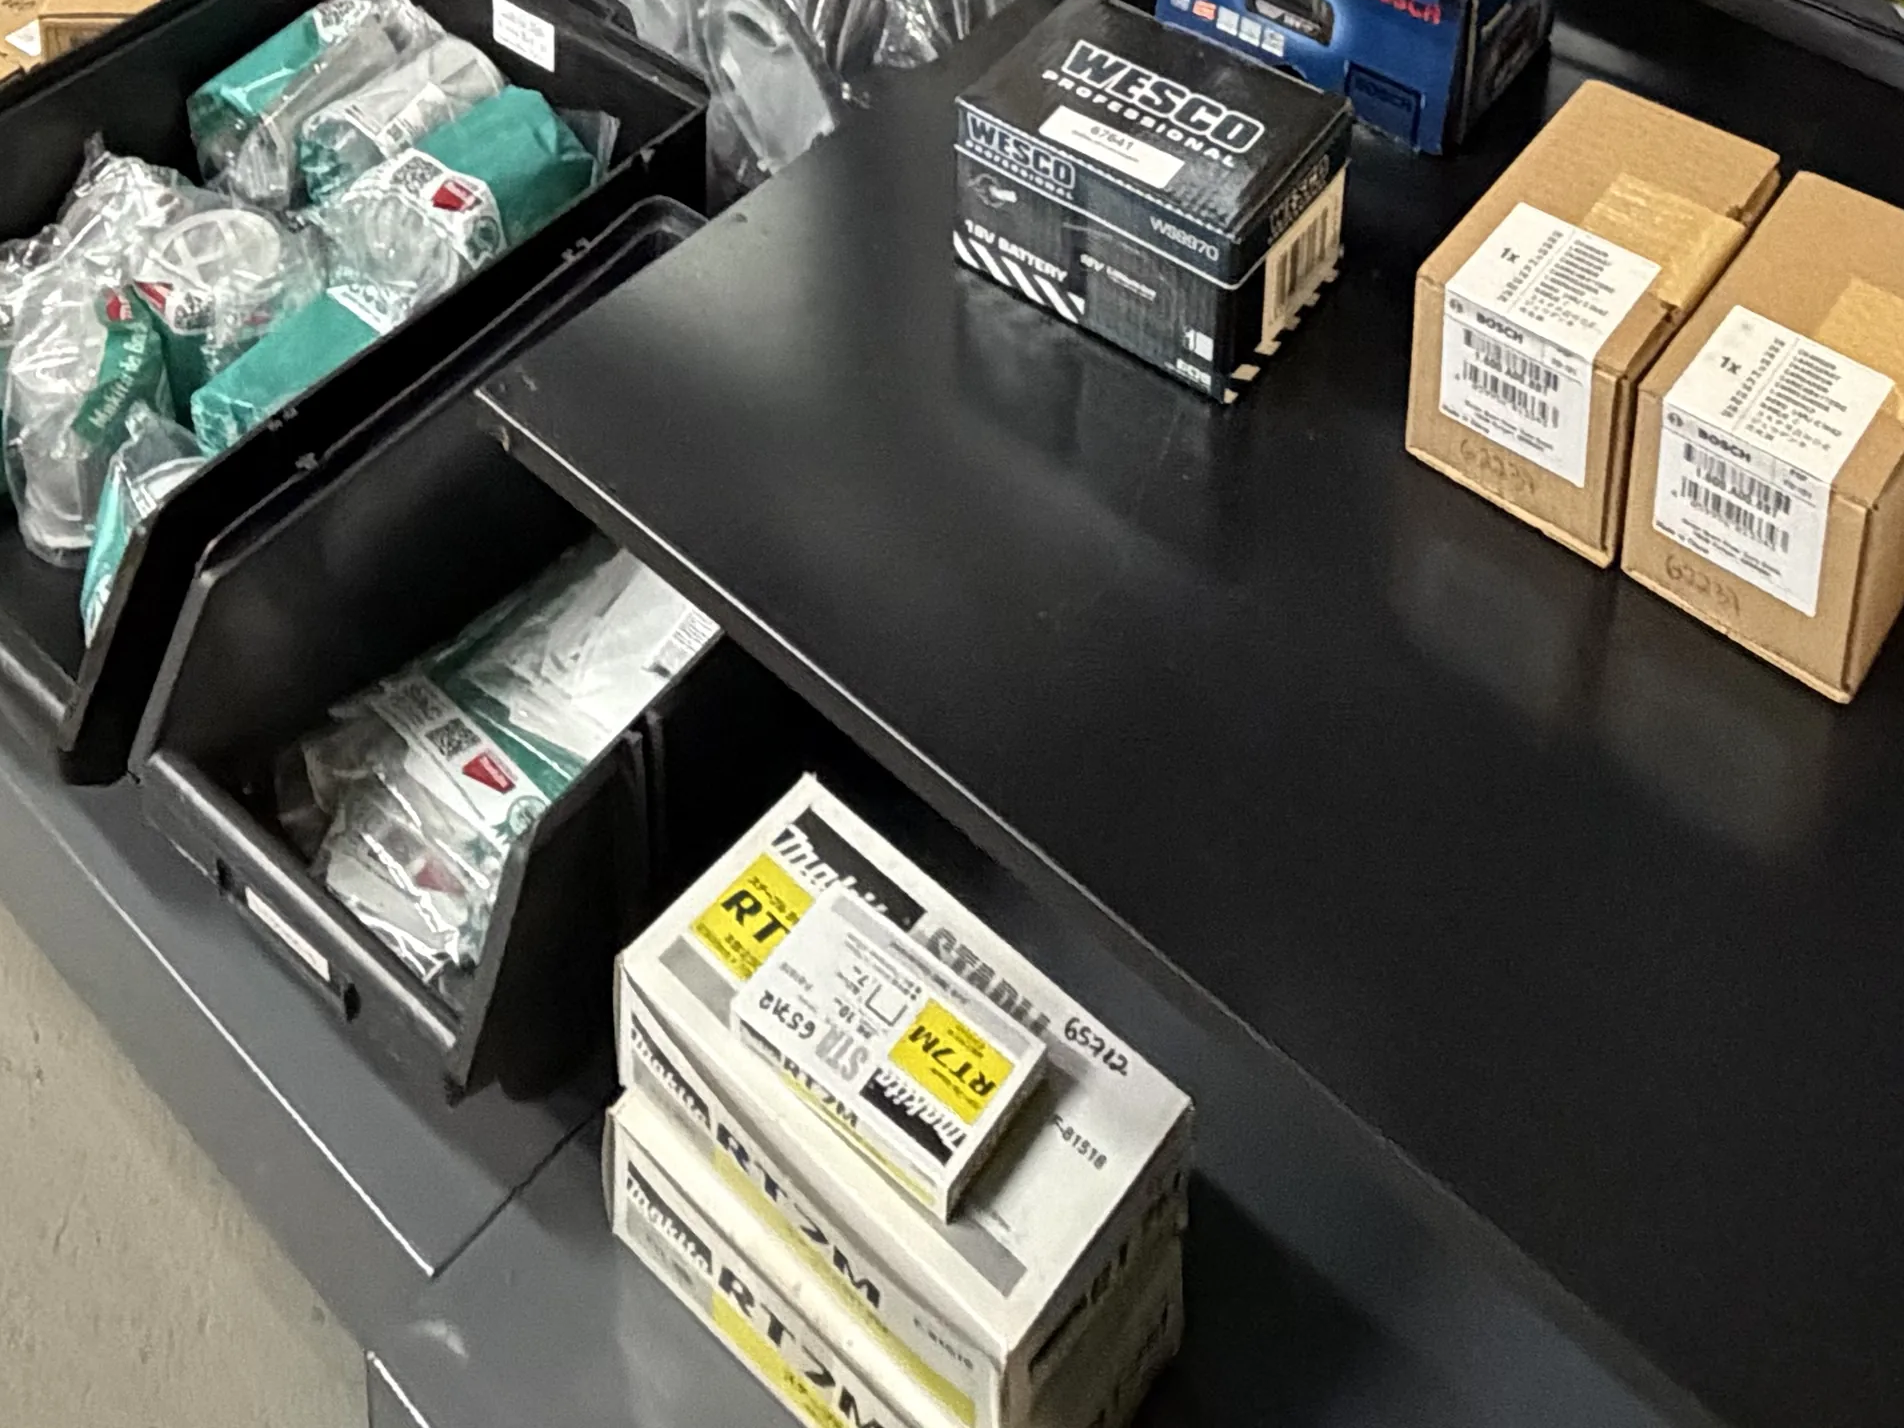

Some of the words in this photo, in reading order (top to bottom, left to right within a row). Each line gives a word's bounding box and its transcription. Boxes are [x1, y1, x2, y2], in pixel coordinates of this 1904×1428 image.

[1042, 69, 1236, 168] PROFESSIONAL
[1060, 39, 1265, 154] WESCO
[964, 139, 1075, 201] PROFESSIONAL
[965, 113, 1076, 190] WESCO
[964, 219, 995, 245] 18V
[997, 235, 1069, 283] BATTERY
[1499, 246, 1521, 265] 1x
[1475, 312, 1525, 345] BOSCH
[1719, 355, 1742, 375] 1x
[1697, 427, 1752, 464] BOSCH
[719, 890, 792, 945] RT
[631, 1027, 711, 1129] makita
[908, 1026, 996, 1099] RT7M
[874, 1064, 968, 1149] makita
[626, 1176, 712, 1278] makita
[716, 1122, 882, 1310] RT7M
[718, 1264, 885, 1428] RT7M
